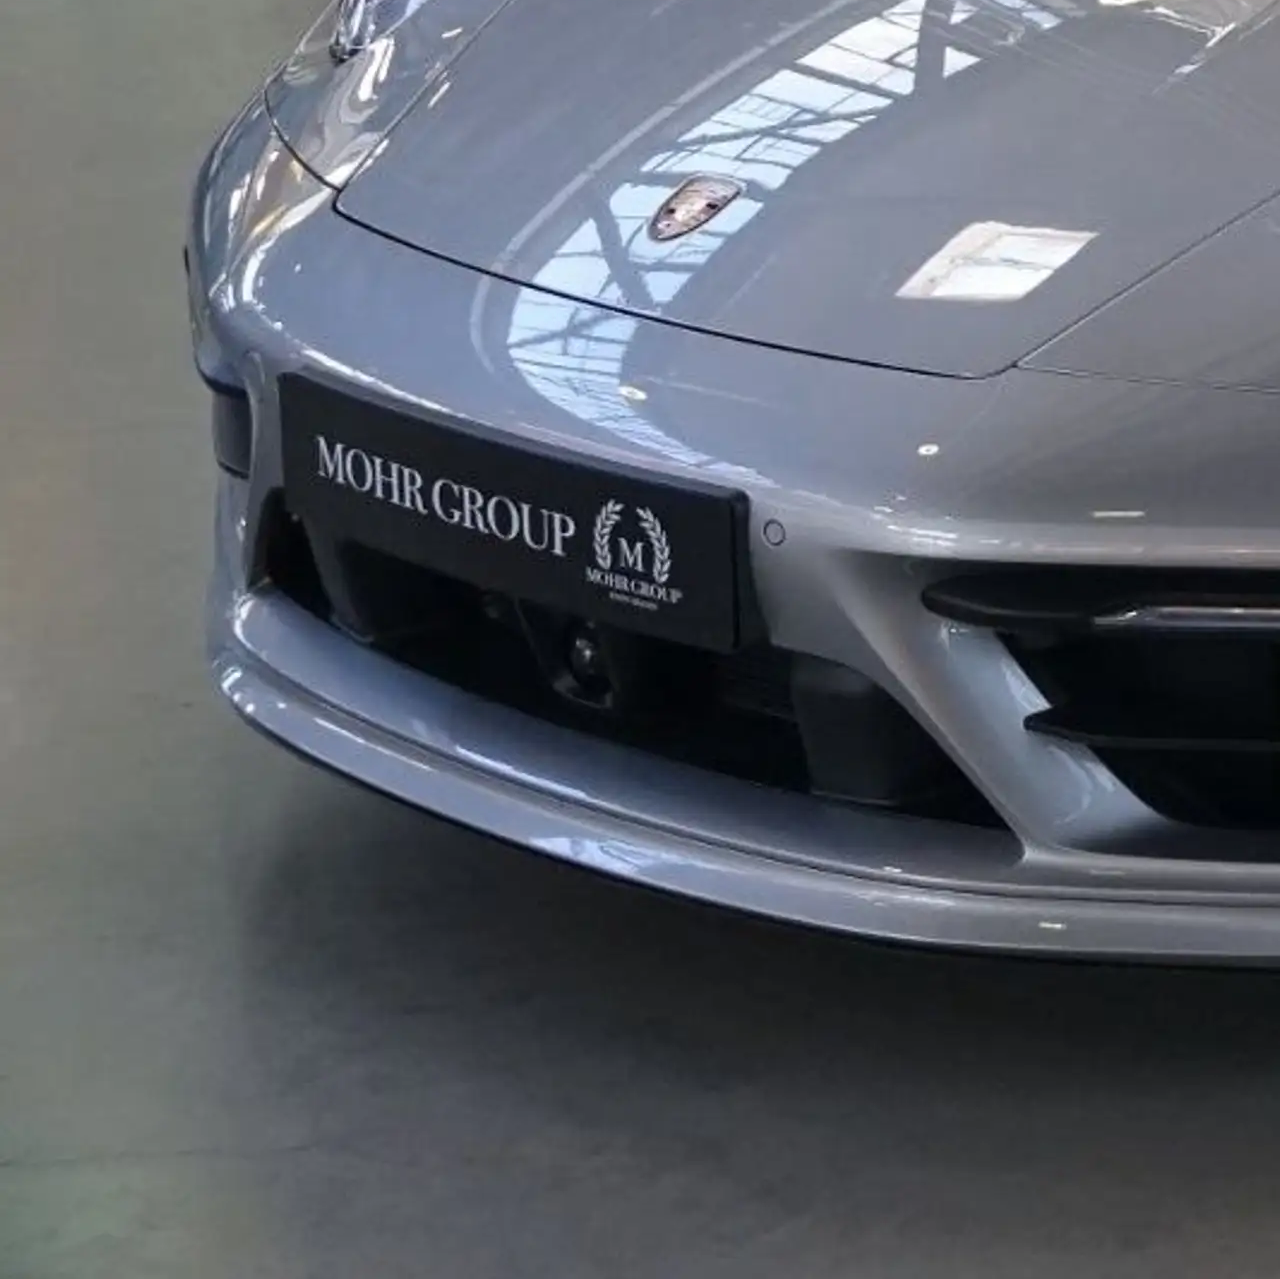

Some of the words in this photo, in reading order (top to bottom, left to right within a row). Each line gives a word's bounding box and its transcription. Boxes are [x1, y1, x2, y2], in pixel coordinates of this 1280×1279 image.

[316, 434, 428, 515] MOHR
[431, 478, 576, 557] GROUP
[617, 537, 645, 572] M
[585, 566, 630, 592] MOHR
